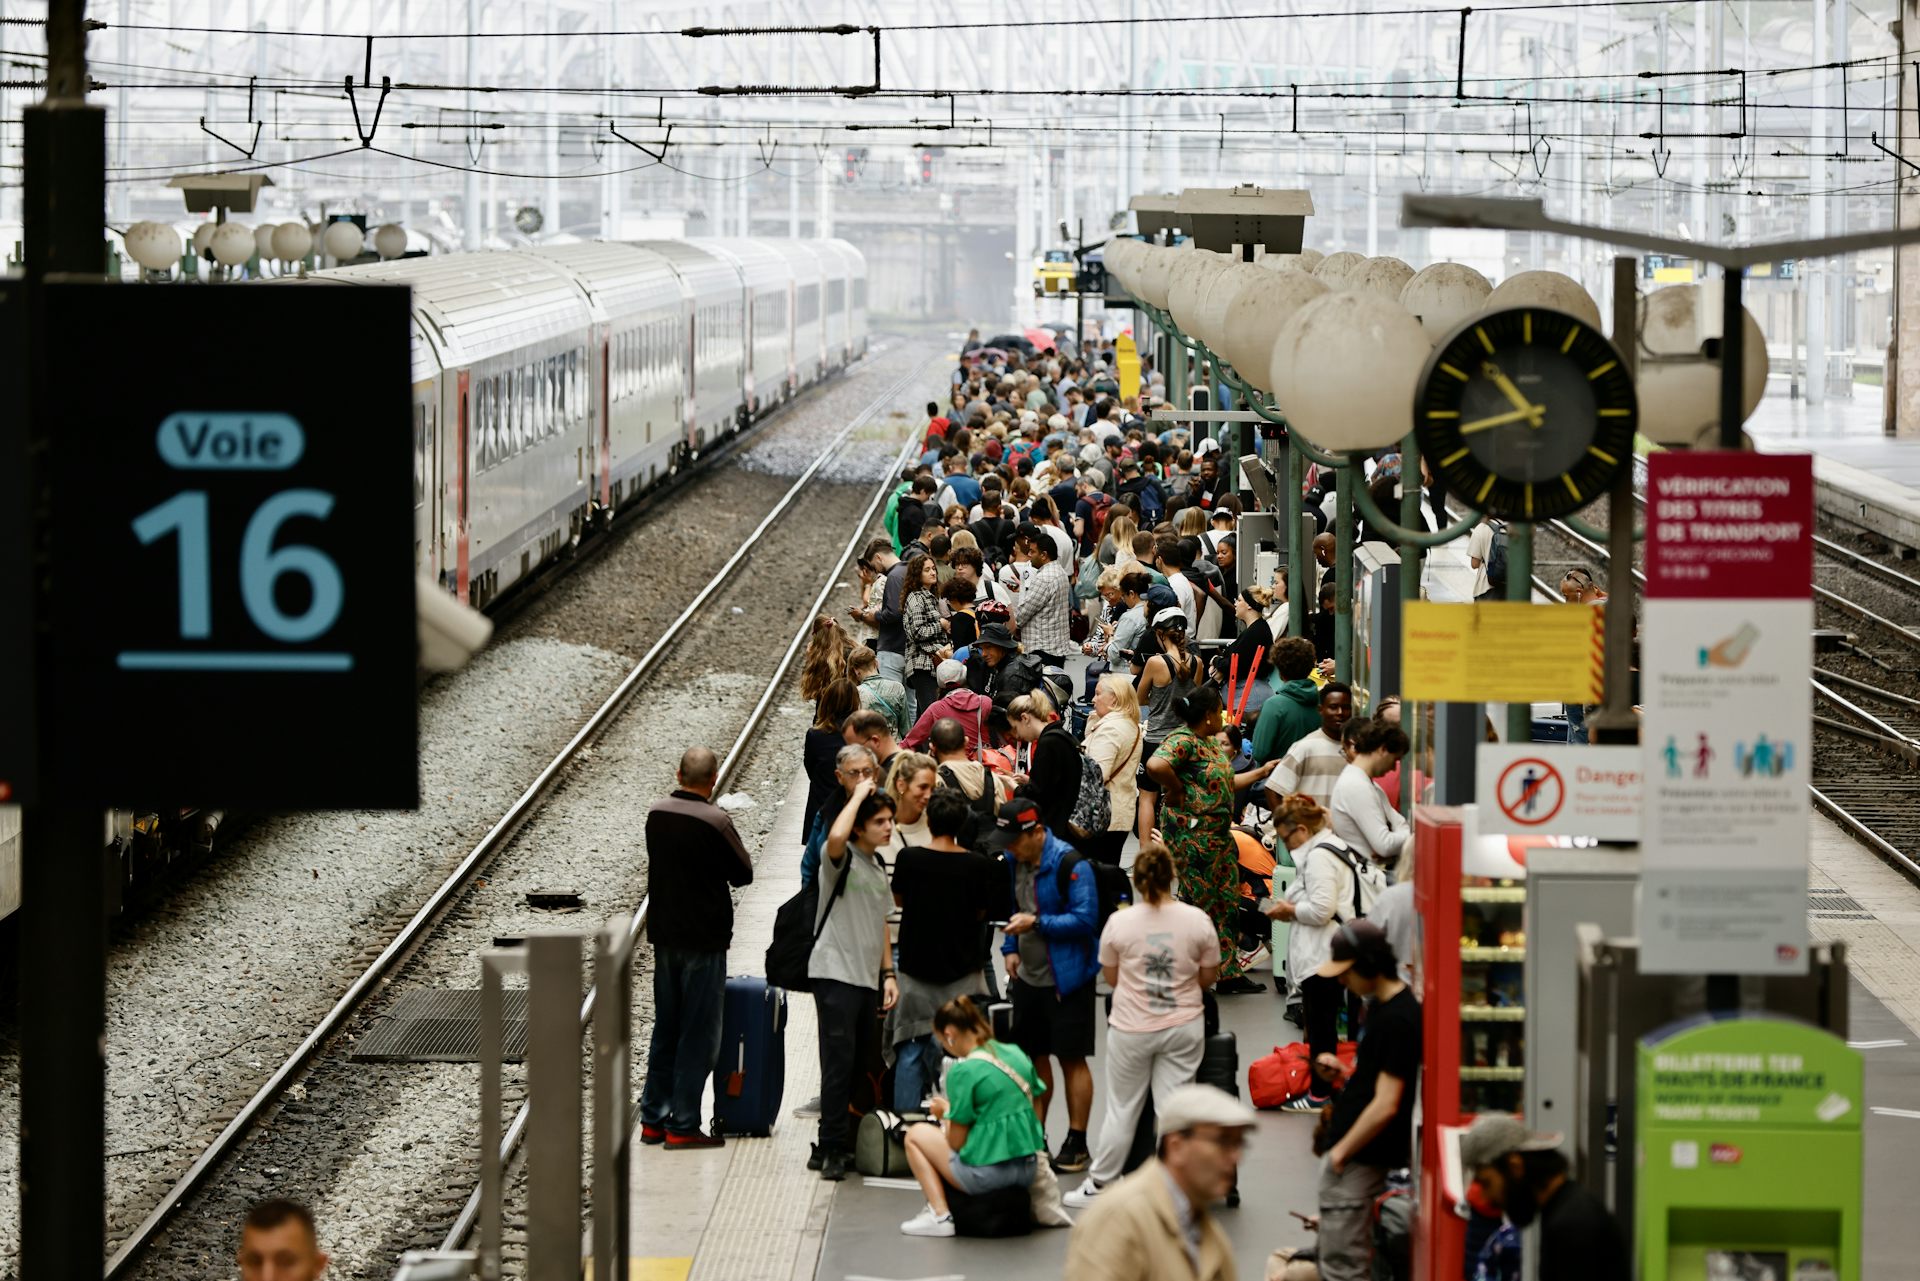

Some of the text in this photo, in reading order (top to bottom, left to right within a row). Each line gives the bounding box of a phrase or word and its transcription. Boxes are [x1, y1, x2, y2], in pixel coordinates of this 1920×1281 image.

[175, 419, 284, 461] Voie
[1656, 500, 1763, 519] DES TITRES
[1656, 523, 1803, 542] DE TRANSPORT
[131, 488, 344, 642] 16
